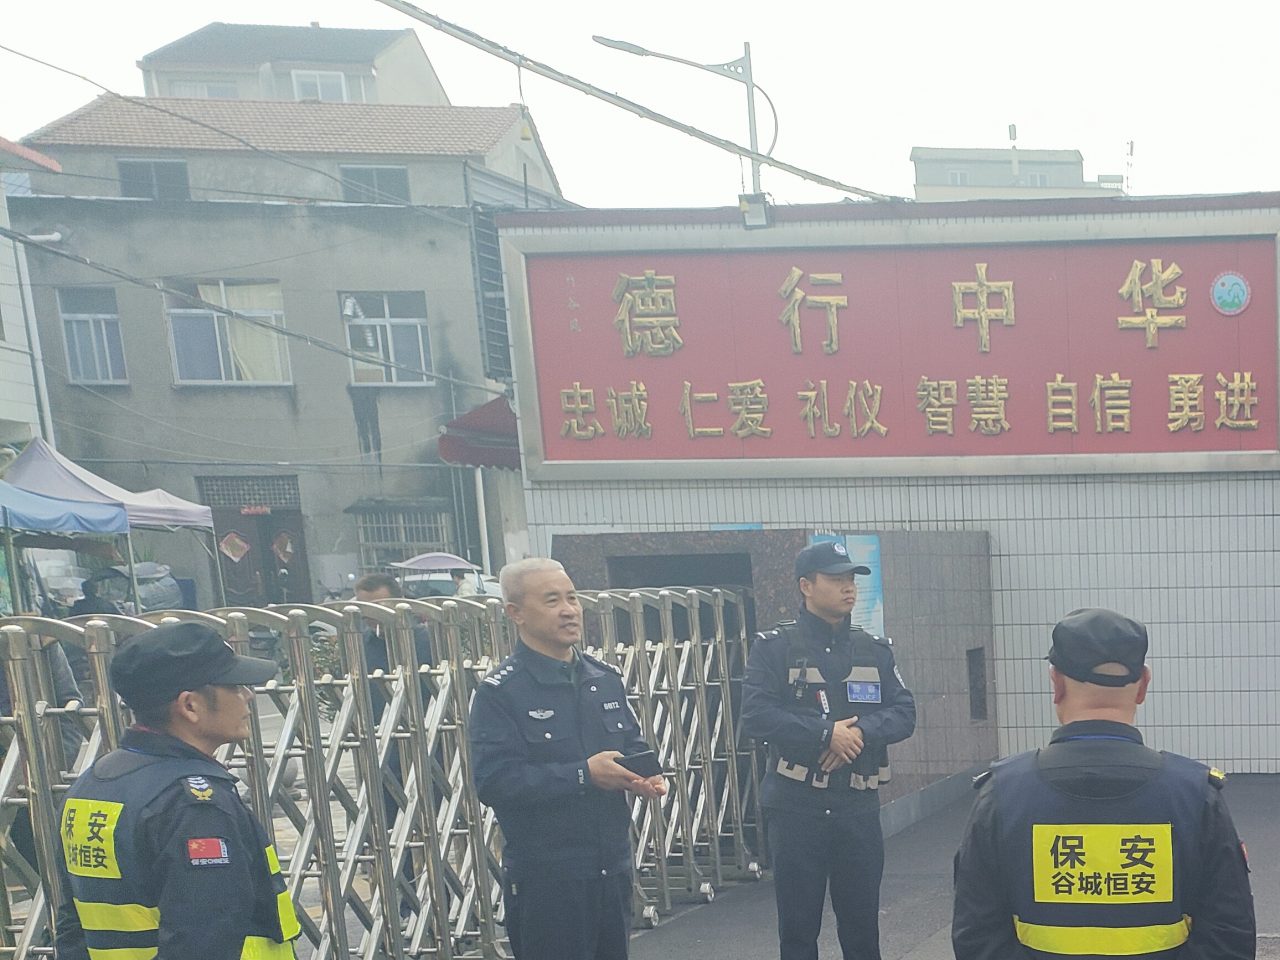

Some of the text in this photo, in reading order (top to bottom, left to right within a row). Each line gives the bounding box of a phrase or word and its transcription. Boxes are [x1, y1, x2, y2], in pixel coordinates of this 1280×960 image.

[560, 371, 1260, 440] 忠诚 仁爱 礼仪 智慧 自信 勇进
[1050, 834, 1156, 869] 保安
[1051, 871, 1156, 896] 谷城恒安
